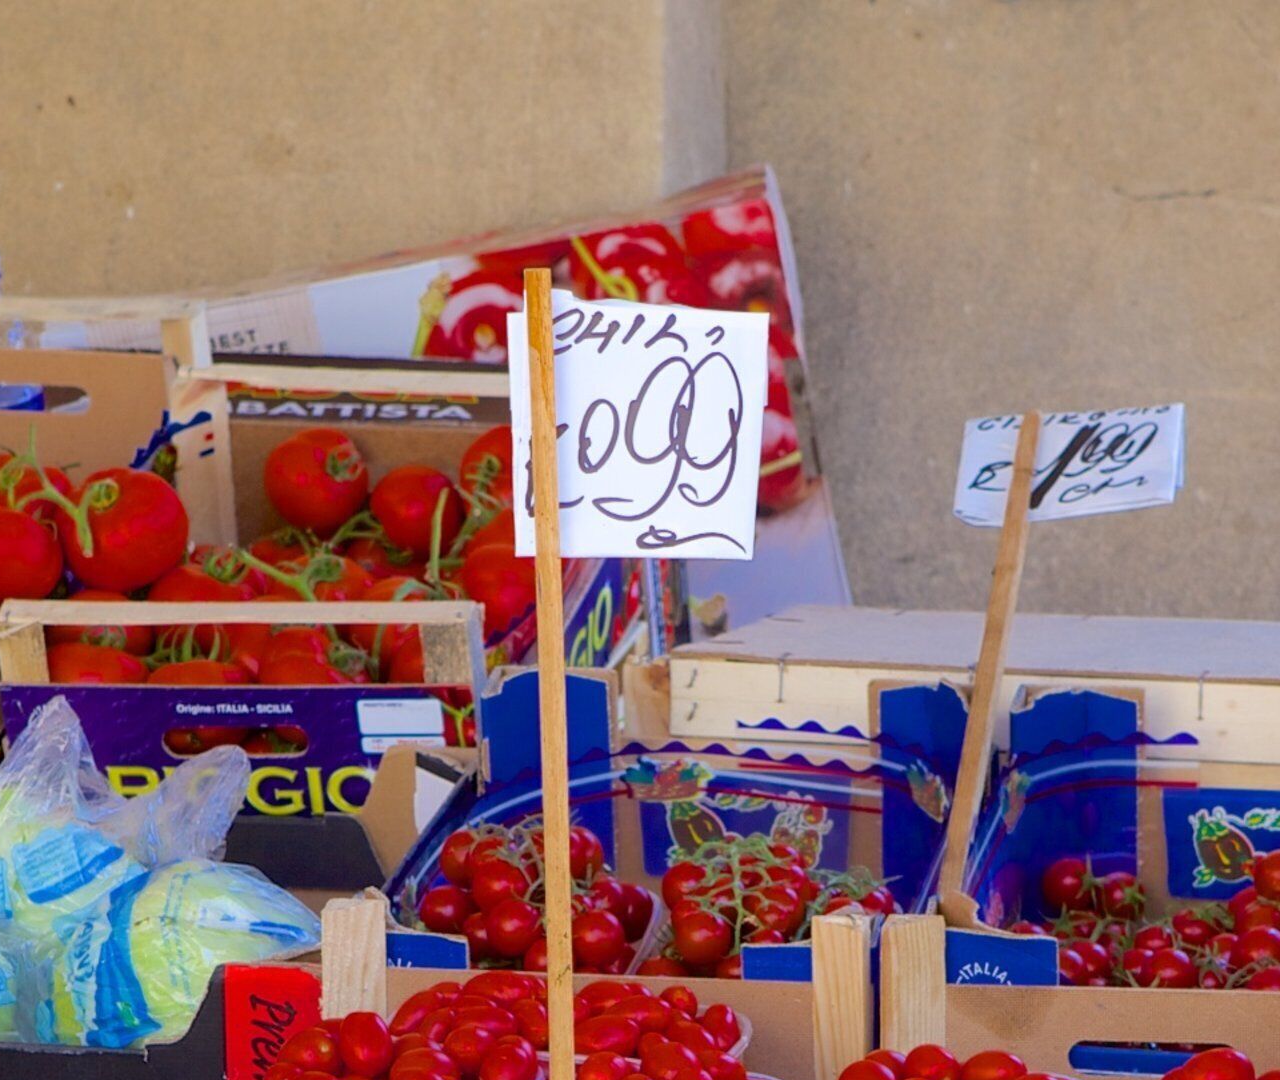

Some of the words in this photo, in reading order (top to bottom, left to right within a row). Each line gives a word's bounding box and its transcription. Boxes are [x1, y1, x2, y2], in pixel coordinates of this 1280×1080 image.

[227, 400, 474, 421] BATTISTA
[176, 703, 215, 716] Origine:
[216, 703, 250, 715] ITALIA
[256, 703, 293, 715] SICILIA
[958, 961, 1008, 984] ITALIA
